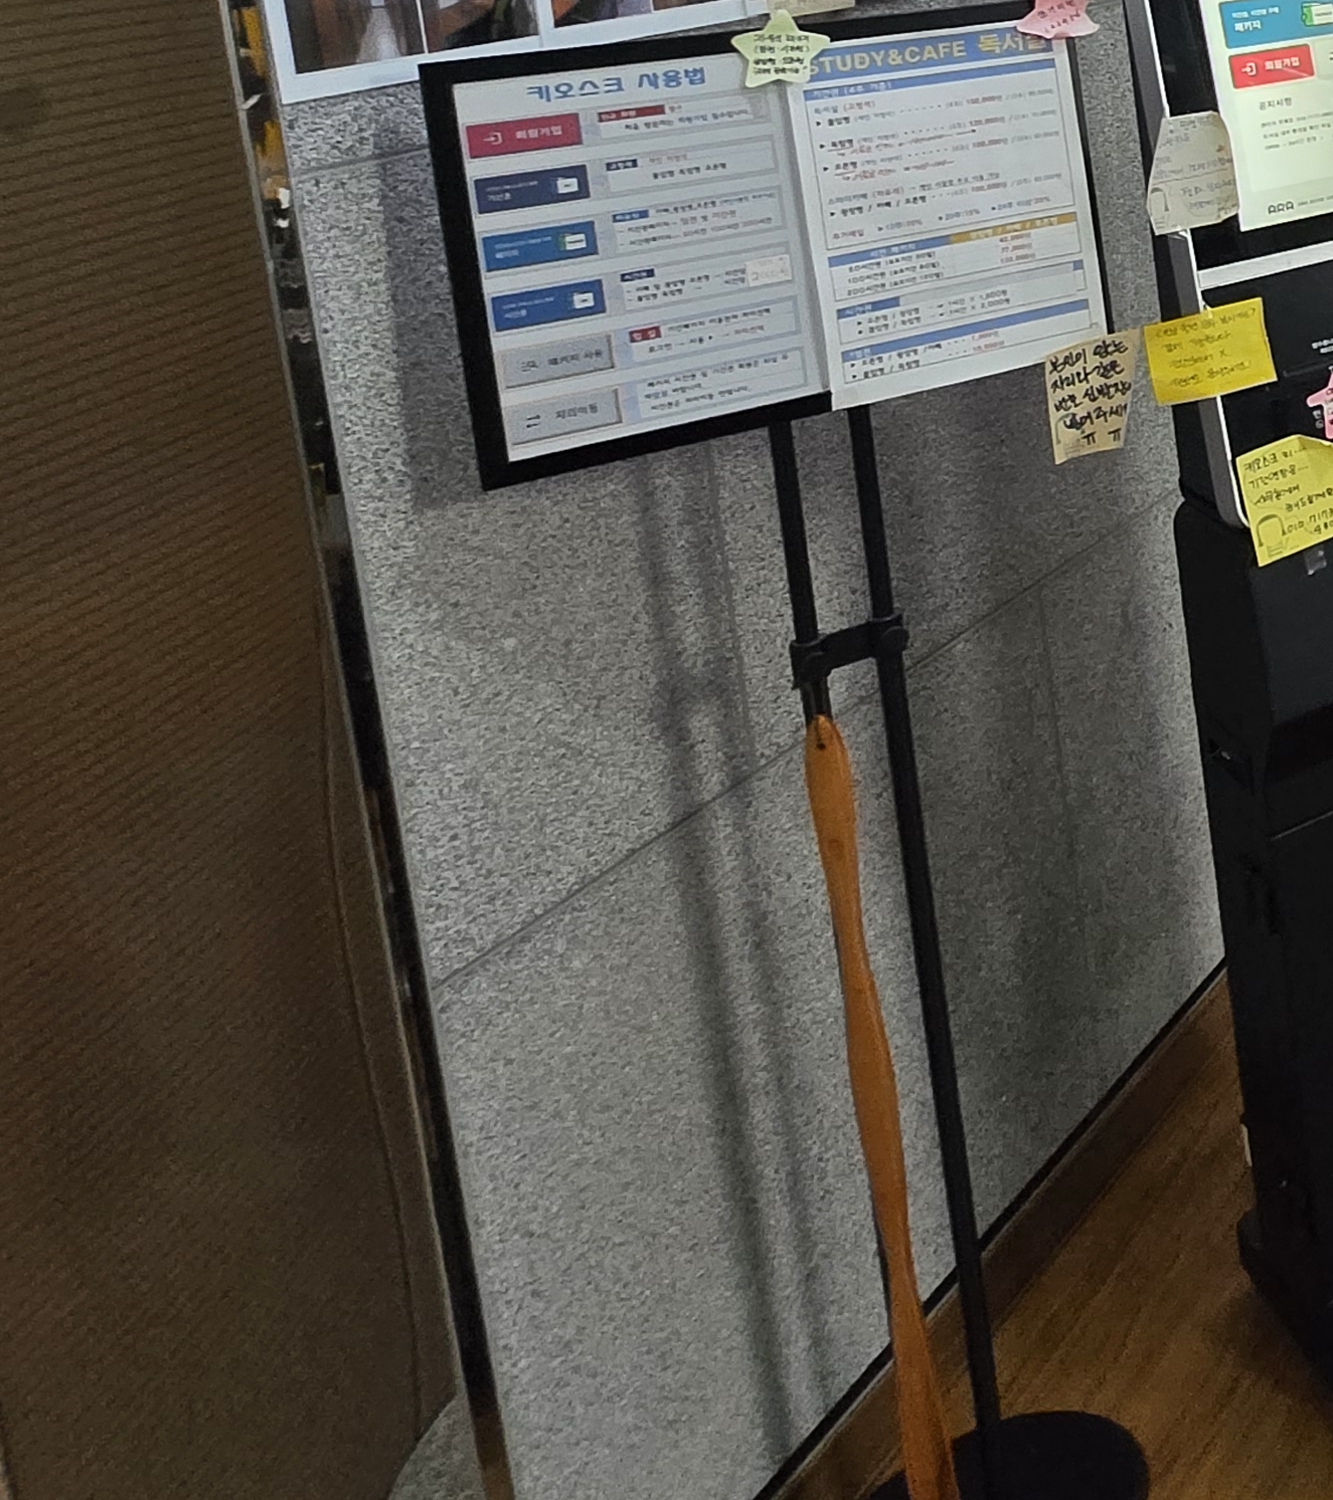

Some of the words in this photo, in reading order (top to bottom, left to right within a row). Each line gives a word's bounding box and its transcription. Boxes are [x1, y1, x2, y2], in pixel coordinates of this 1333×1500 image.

[527, 77, 625, 102] 키오스크
[637, 67, 706, 90] 사용법
[1267, 201, 1296, 215] ARA
